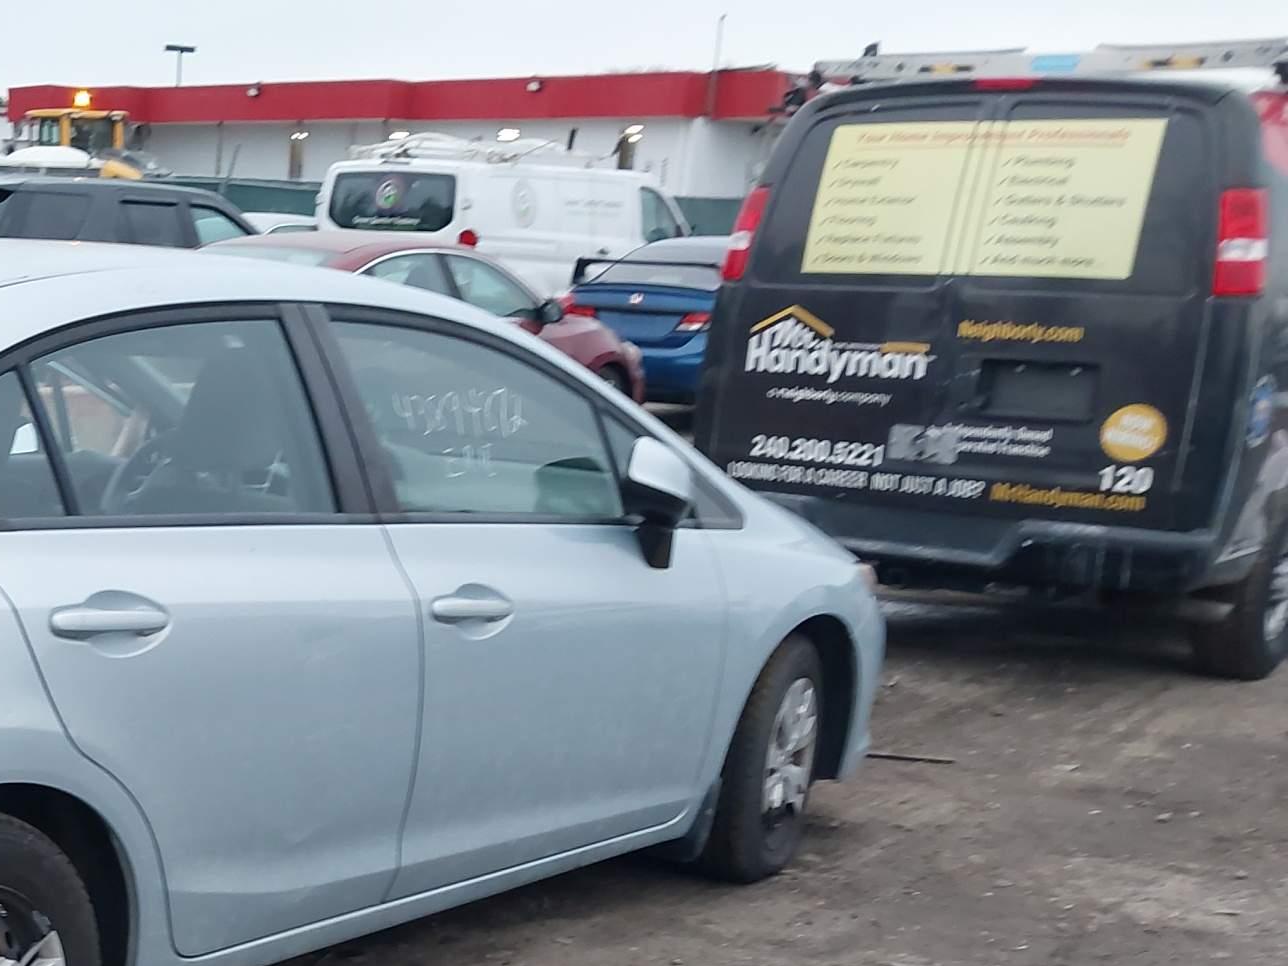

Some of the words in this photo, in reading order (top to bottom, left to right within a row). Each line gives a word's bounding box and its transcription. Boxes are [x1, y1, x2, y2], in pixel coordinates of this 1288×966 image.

[956, 320, 1085, 344] Neighborly.com
[744, 333, 931, 384] Handyman
[816, 467, 871, 490] CAREER
[870, 470, 902, 492] NOT
[900, 474, 937, 495] JUST
[1097, 463, 1155, 495] 120
